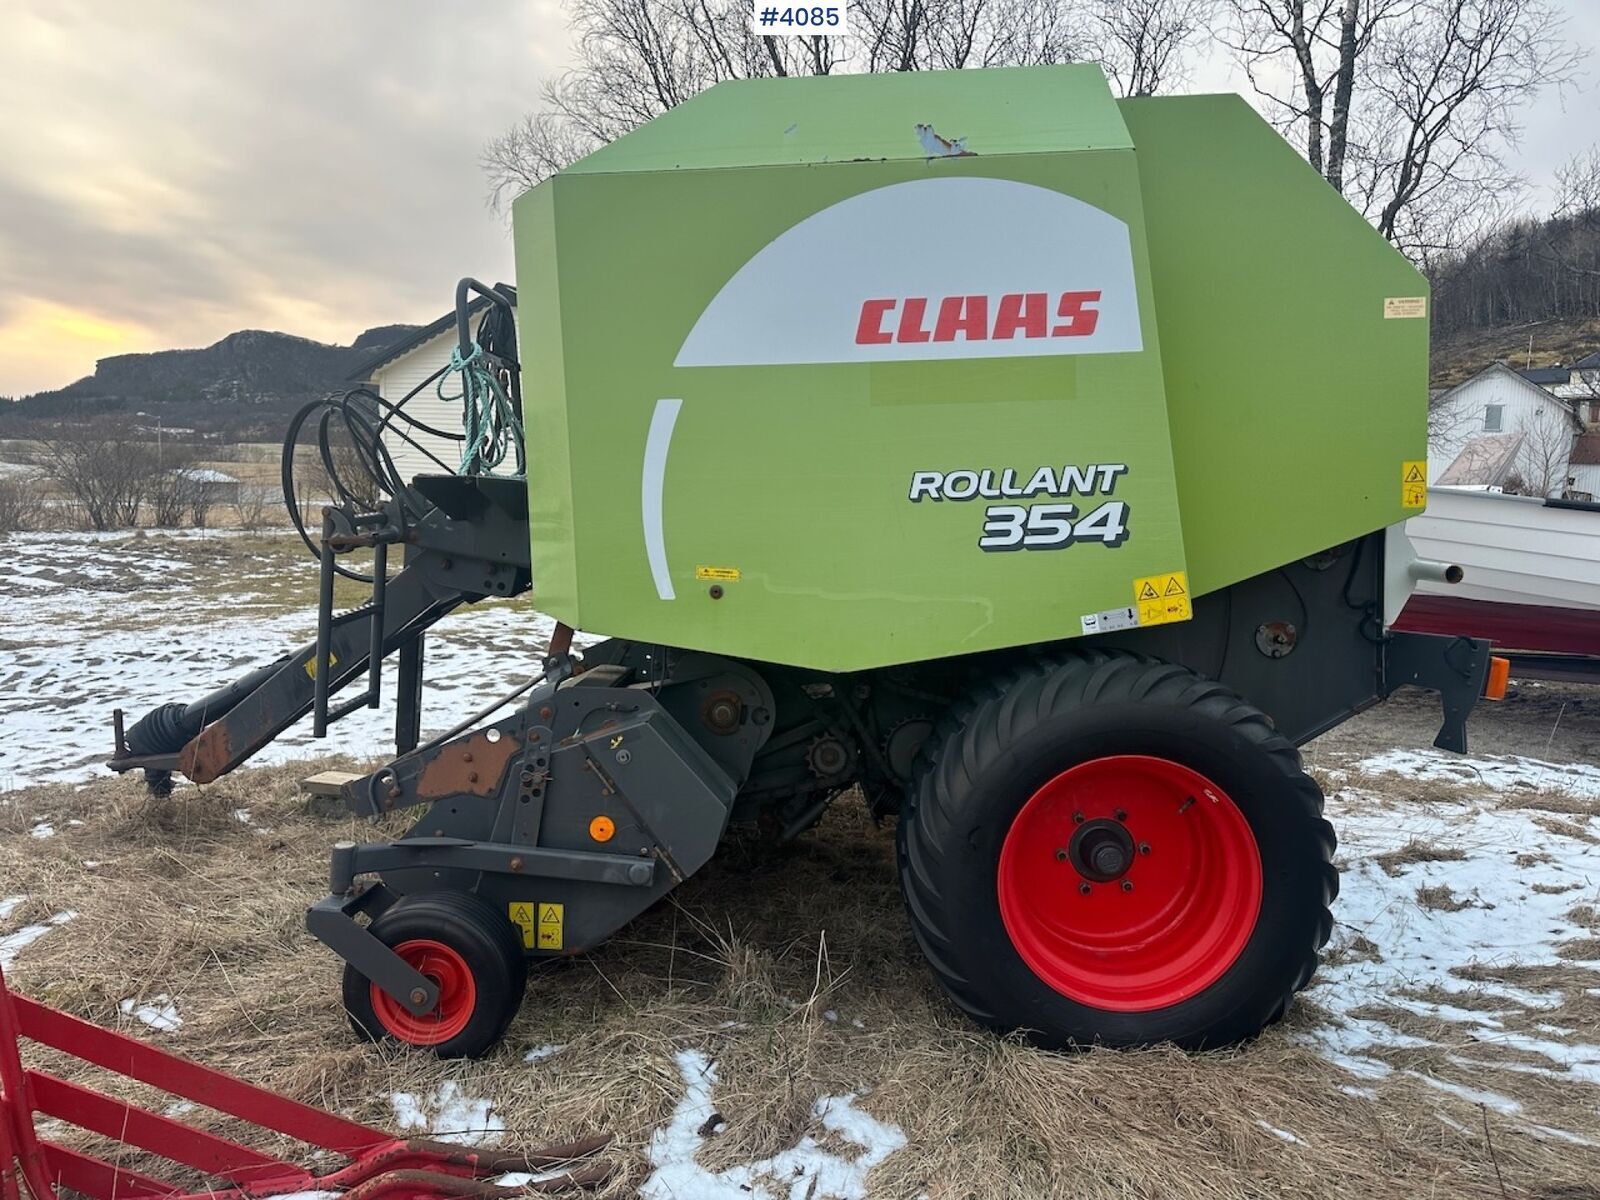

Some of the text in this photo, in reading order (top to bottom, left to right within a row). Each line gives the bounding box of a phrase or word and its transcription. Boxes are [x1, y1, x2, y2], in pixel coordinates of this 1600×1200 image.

[855, 291, 1102, 344] CLAAS
[909, 464, 1128, 502] ROLLANT
[979, 501, 1130, 552] 354
